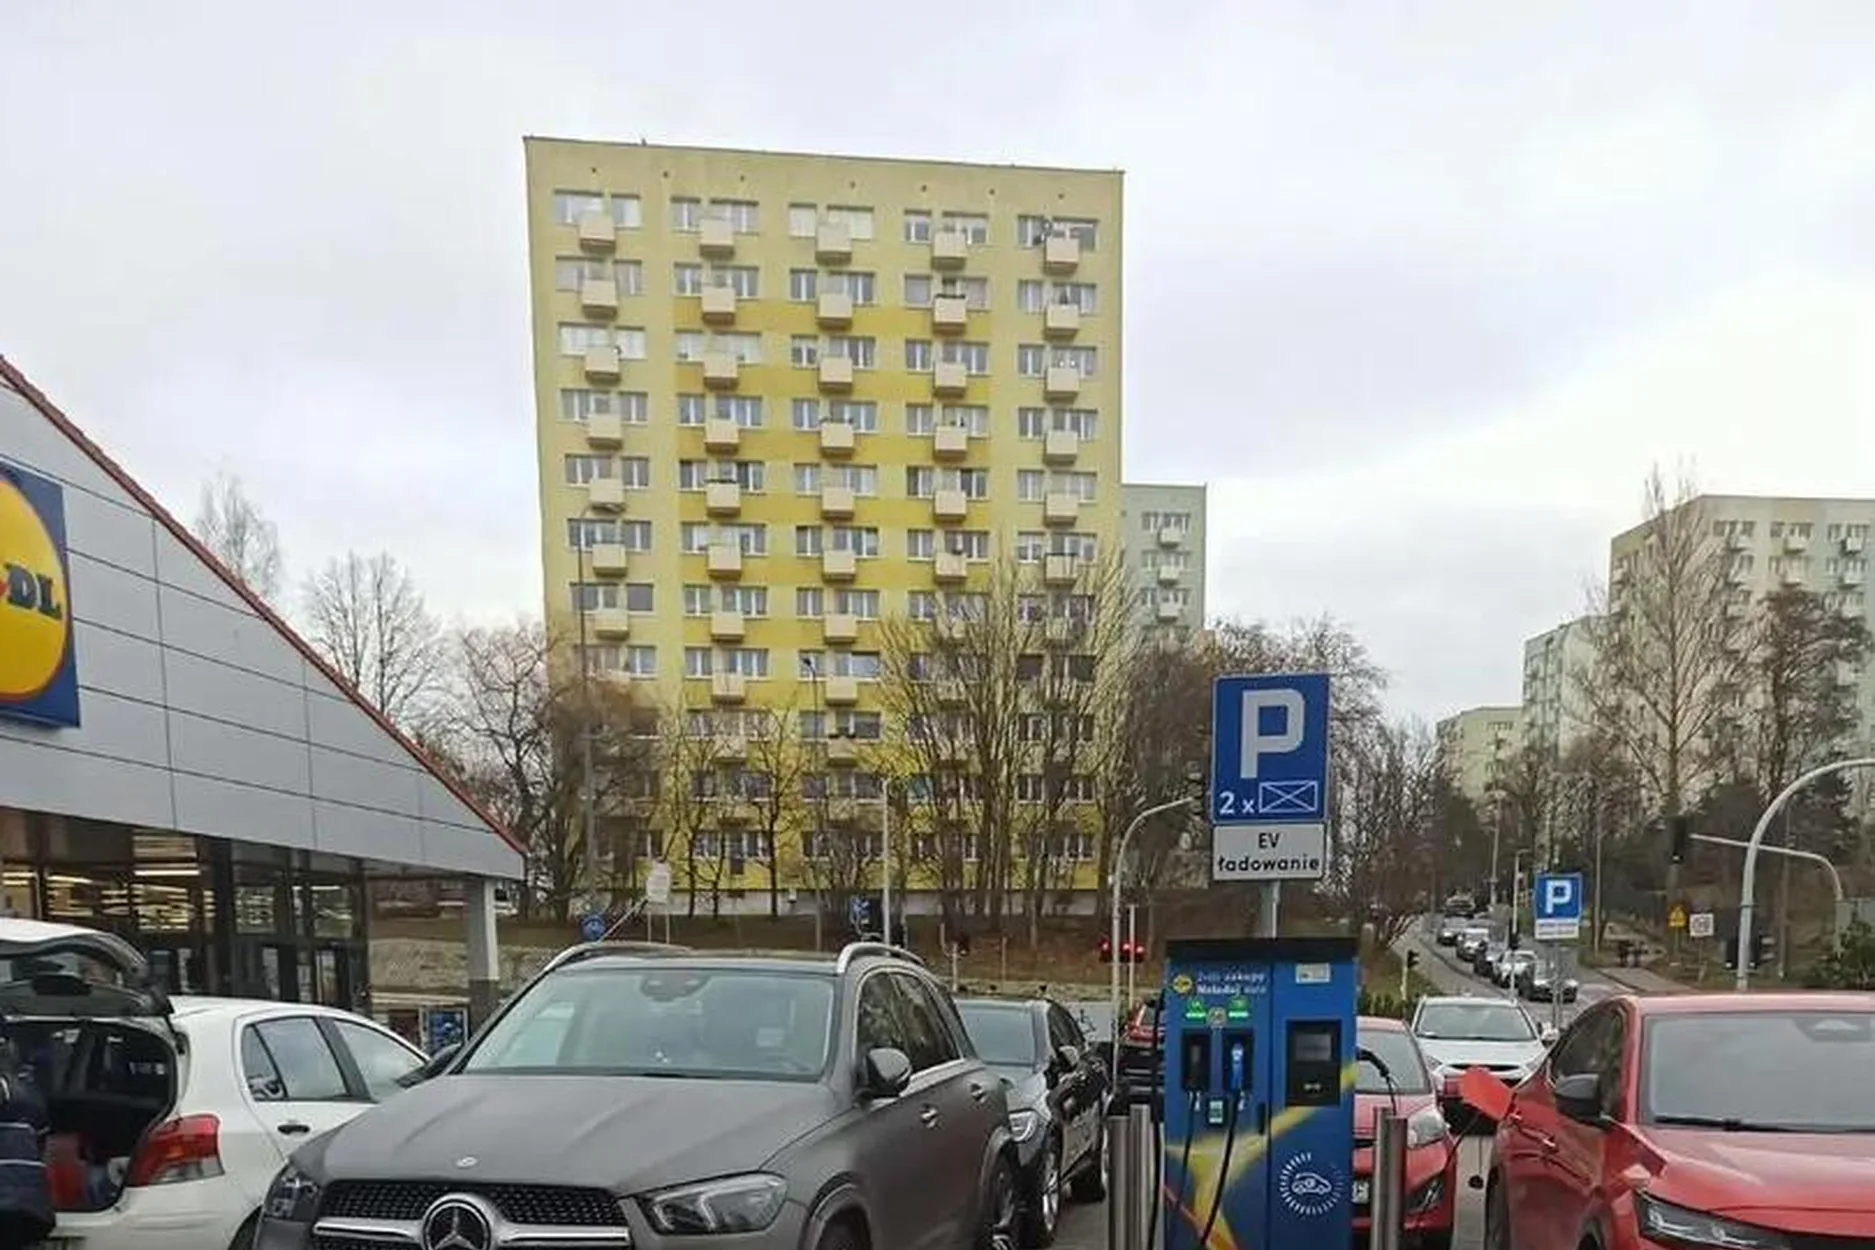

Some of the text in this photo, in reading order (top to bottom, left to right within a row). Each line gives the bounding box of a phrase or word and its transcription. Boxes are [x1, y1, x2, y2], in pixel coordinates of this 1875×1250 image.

[1240, 688, 1306, 778] P
[1257, 832, 1281, 849] EV
[1217, 853, 1320, 872] ładowanie
[1545, 880, 1573, 914] P
